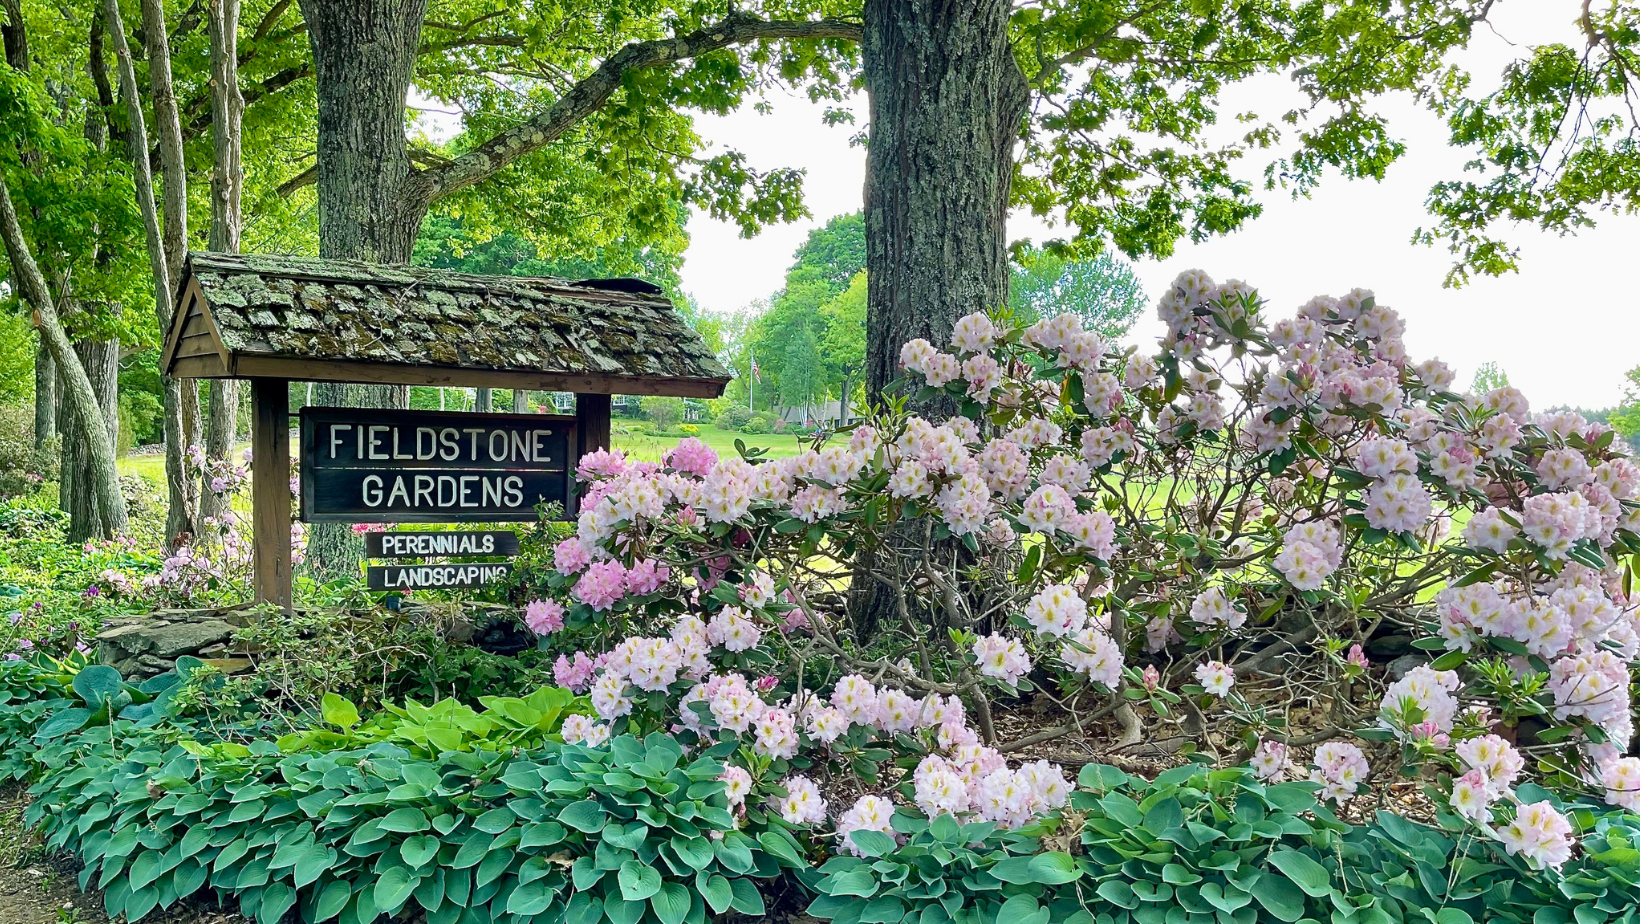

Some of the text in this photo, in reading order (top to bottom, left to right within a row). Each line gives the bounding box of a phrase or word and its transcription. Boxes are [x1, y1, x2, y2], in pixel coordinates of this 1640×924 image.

[330, 424, 552, 462] FIELDSTONE
[362, 475, 524, 507] GARDENS
[382, 534, 494, 554] PERENNIALS
